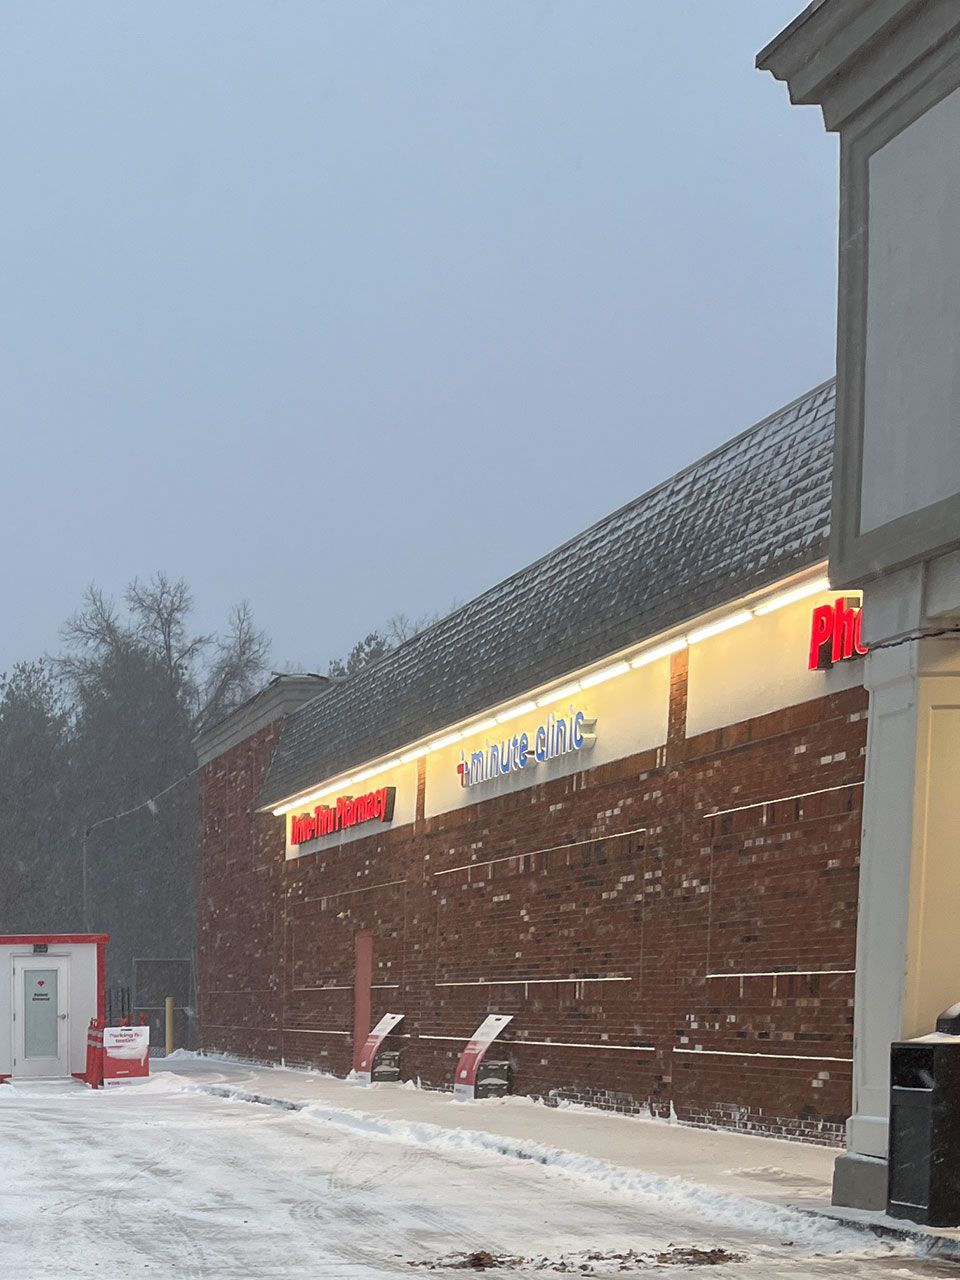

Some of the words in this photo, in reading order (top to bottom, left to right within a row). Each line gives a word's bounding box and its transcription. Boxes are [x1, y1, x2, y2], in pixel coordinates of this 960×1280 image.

[469, 732, 528, 785] minute
[535, 704, 585, 762] clinic
[291, 804, 335, 845] Drive-Thru
[335, 787, 388, 831] Pharmacy
